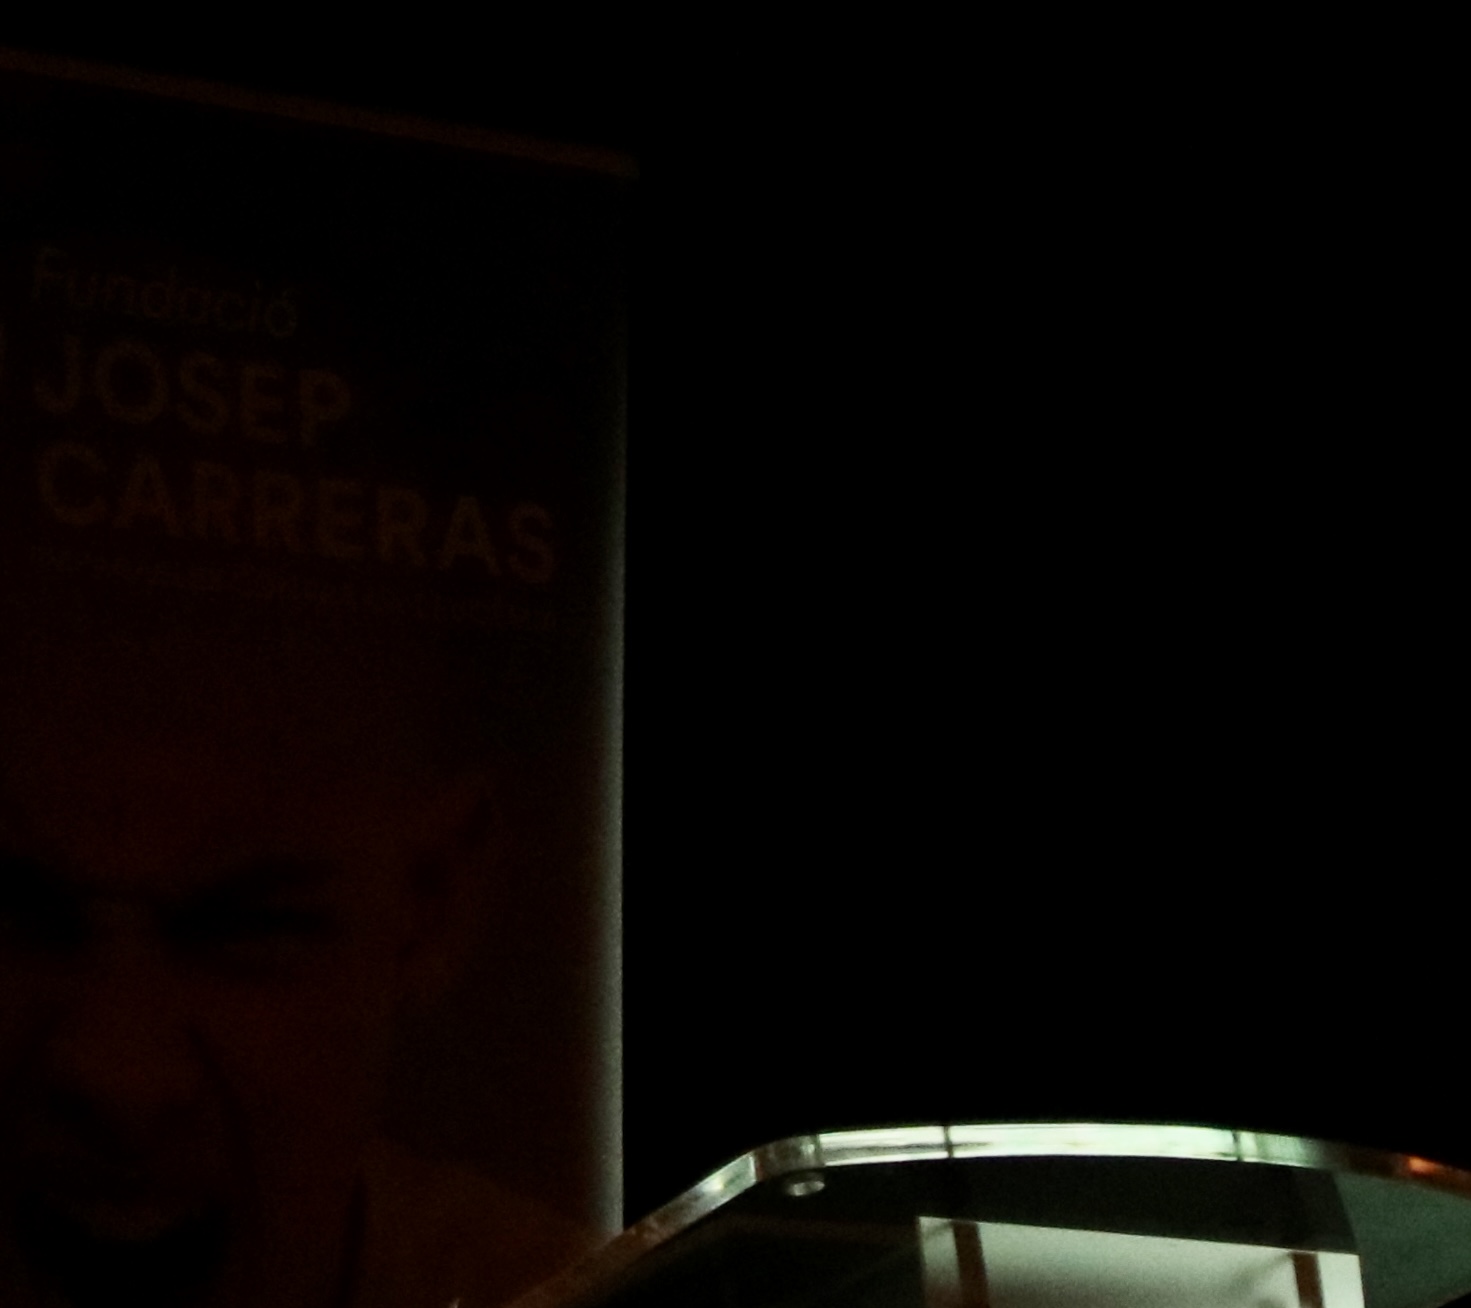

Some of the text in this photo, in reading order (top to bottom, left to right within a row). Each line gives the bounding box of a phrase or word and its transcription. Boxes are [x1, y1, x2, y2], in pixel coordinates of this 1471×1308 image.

[32, 244, 299, 338] Fundació
[32, 333, 352, 446] JOSEP
[36, 440, 556, 584] CARRERAS
